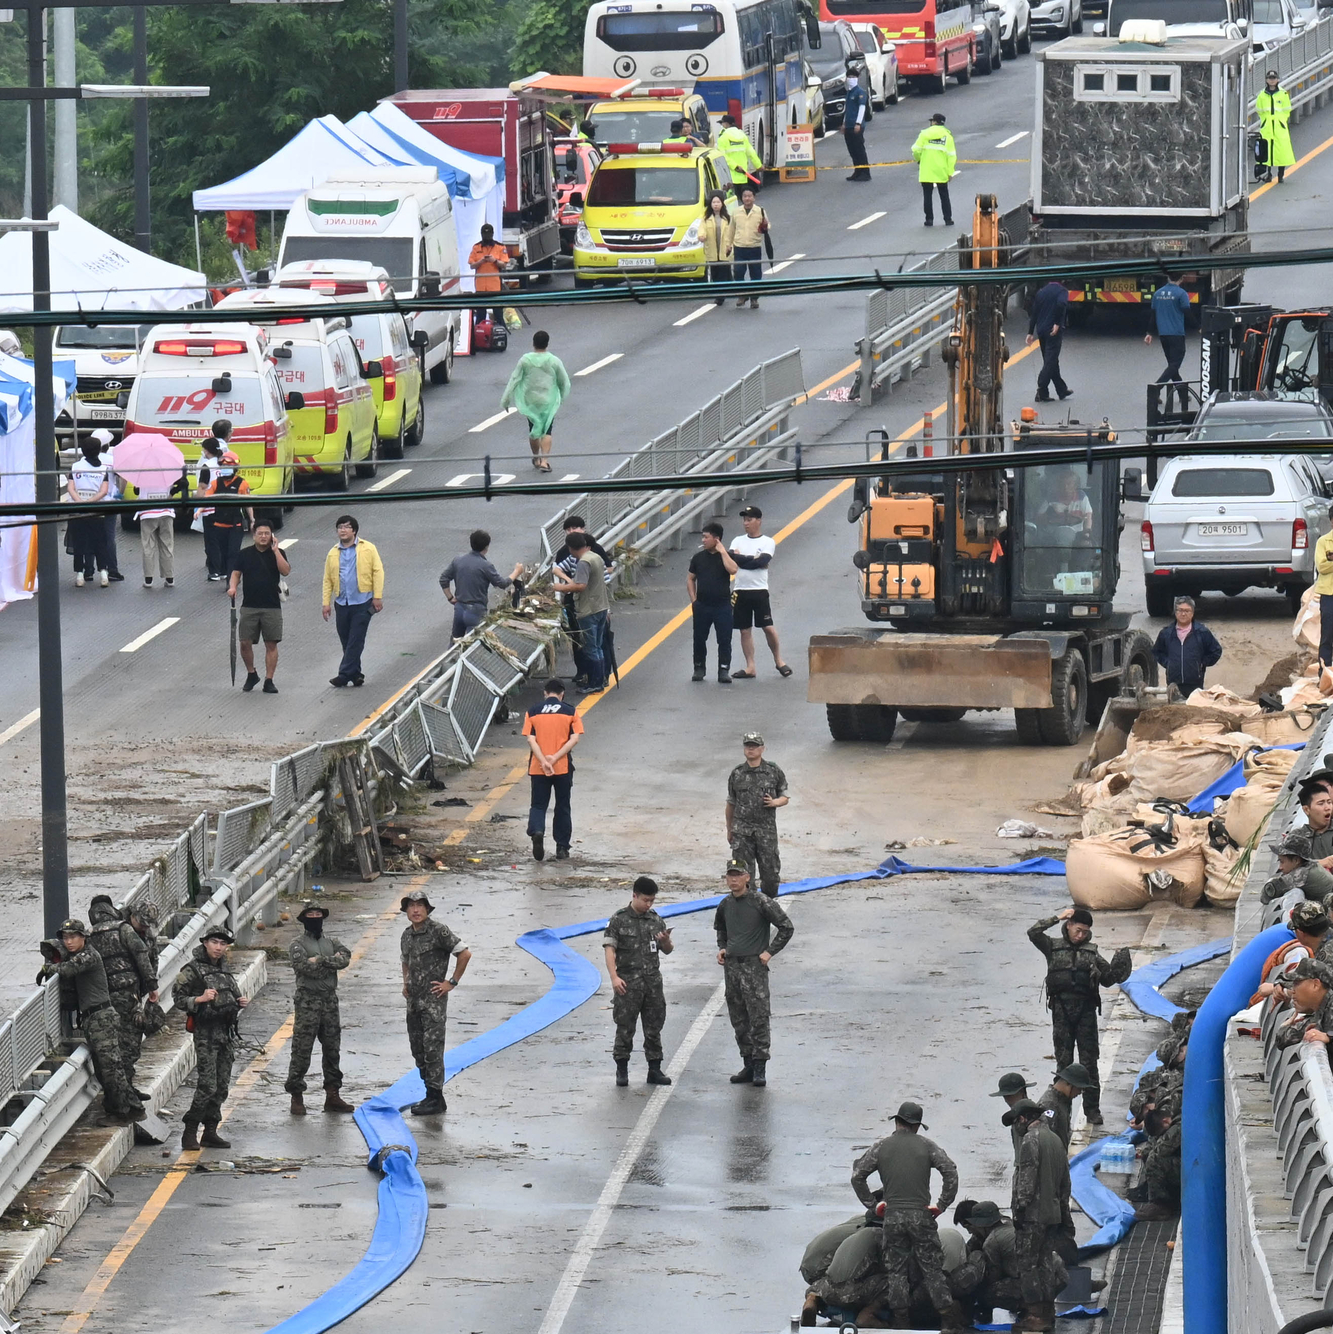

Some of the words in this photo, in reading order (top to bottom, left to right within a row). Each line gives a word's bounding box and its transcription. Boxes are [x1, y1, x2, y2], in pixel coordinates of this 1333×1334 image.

[433, 103, 462, 119] 119
[1201, 337, 1211, 402] DOOSAN
[155, 388, 217, 415] 119
[213, 402, 245, 415] 구급대
[1221, 525, 1242, 534] 9501
[541, 703, 562, 714] 119
